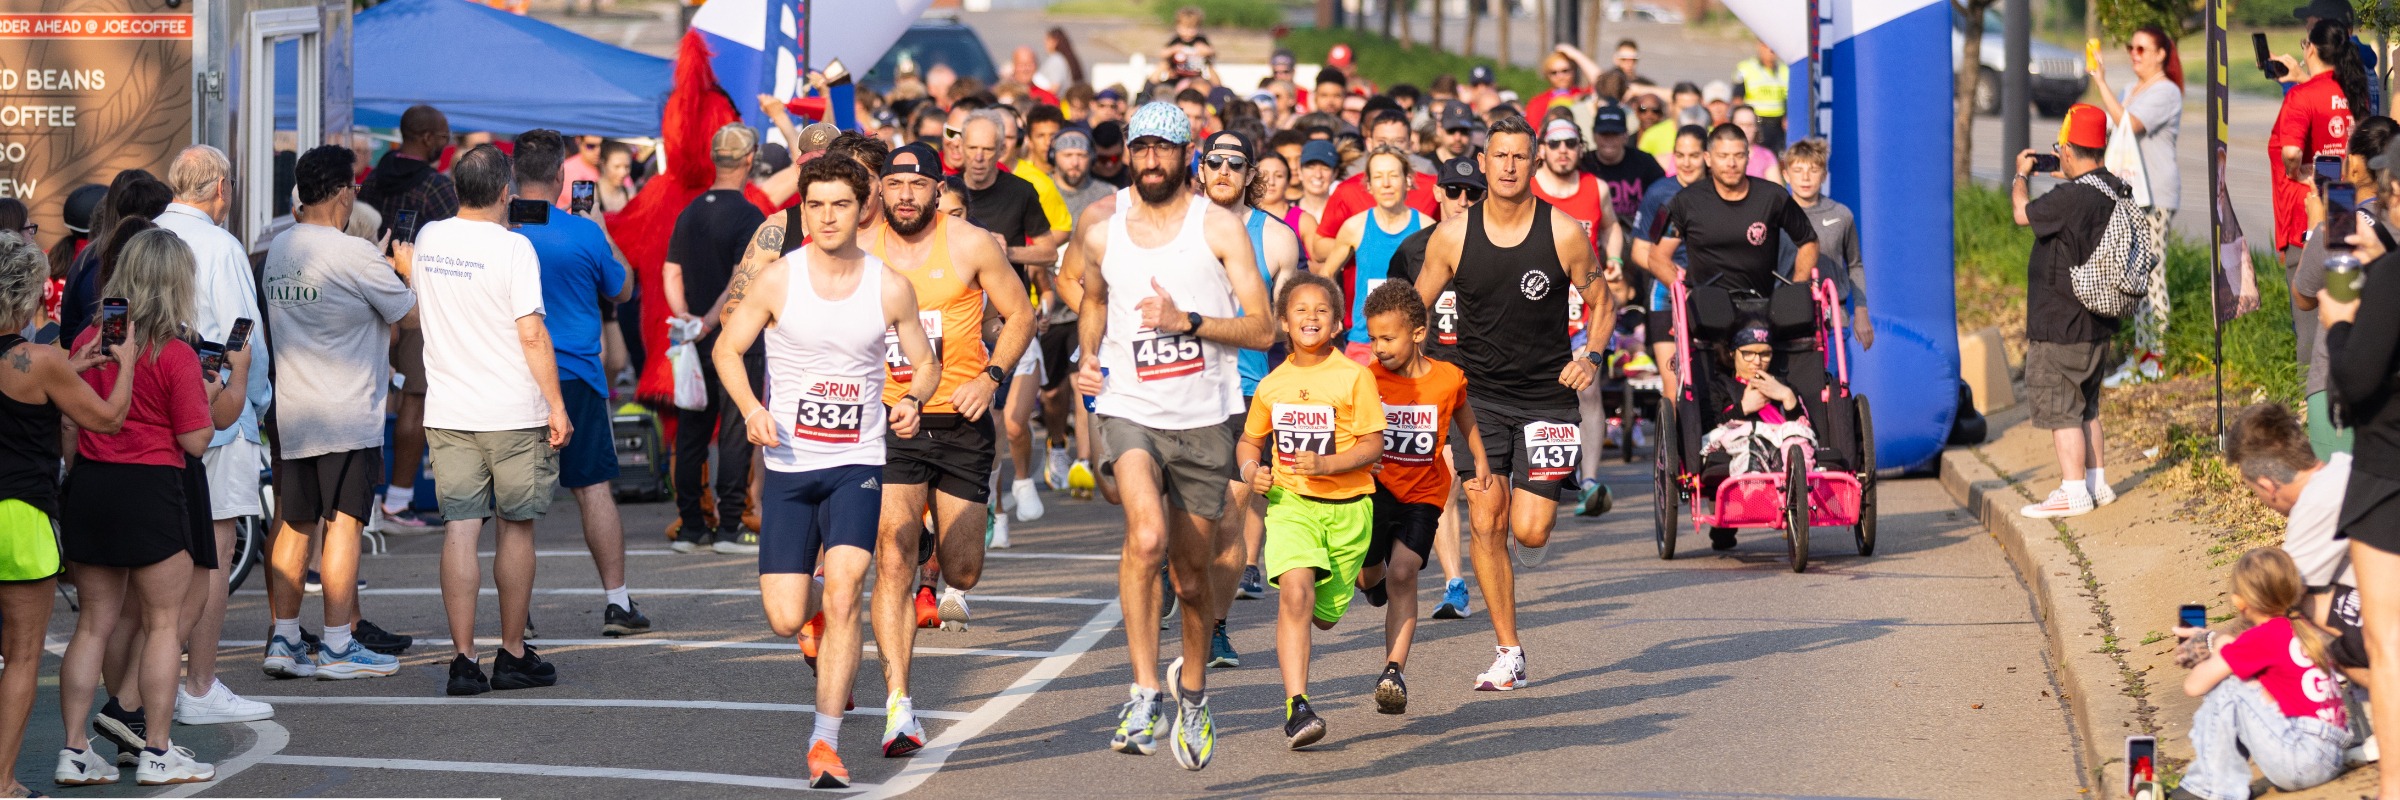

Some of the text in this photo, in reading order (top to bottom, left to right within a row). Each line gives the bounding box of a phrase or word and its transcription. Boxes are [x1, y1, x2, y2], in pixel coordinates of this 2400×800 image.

[35, 20, 81, 34] AHEAD
[85, 20, 98, 34] @
[102, 19, 187, 35] JOE.COFFEE
[26, 69, 106, 91] BEANS
[1137, 335, 1200, 366] 455
[829, 382, 860, 398] RUN
[799, 401, 859, 430] 334
[1298, 412, 1328, 426] RUN
[1402, 411, 1432, 425] RUN
[1549, 426, 1574, 439] RUN
[1278, 431, 1331, 456] 577
[1383, 431, 1434, 456] 579
[1531, 445, 1579, 468] 437
[149, 760, 166, 771] TYR
